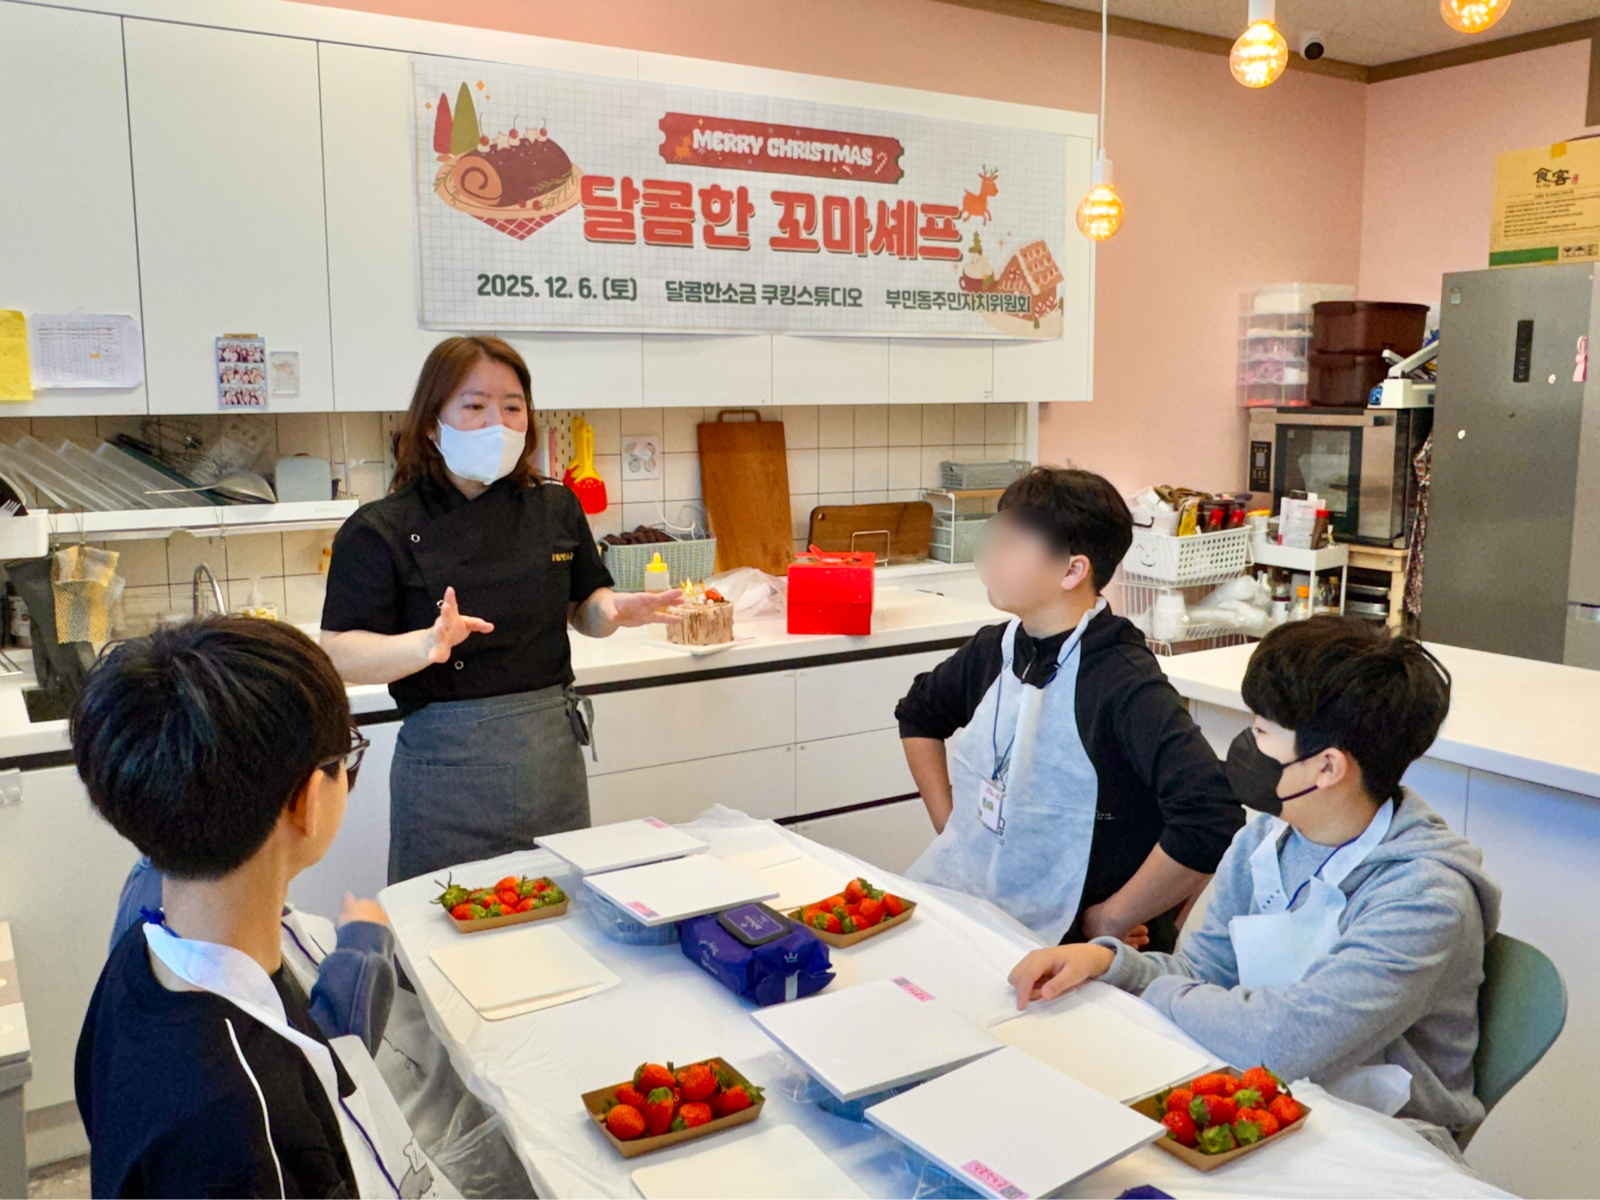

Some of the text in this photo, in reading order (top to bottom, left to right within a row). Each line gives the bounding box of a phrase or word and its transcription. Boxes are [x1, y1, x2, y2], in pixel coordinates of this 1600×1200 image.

[692, 128, 873, 167] MERRY CHRISTMAS
[580, 174, 963, 260] 달콤한 꼬마셰프
[477, 273, 637, 301] 2025. 12. 6. (토)
[665, 280, 863, 307] 달콤한소금 쿠킹스튜디오
[886, 289, 1031, 314] 부민동주민자치위원회
